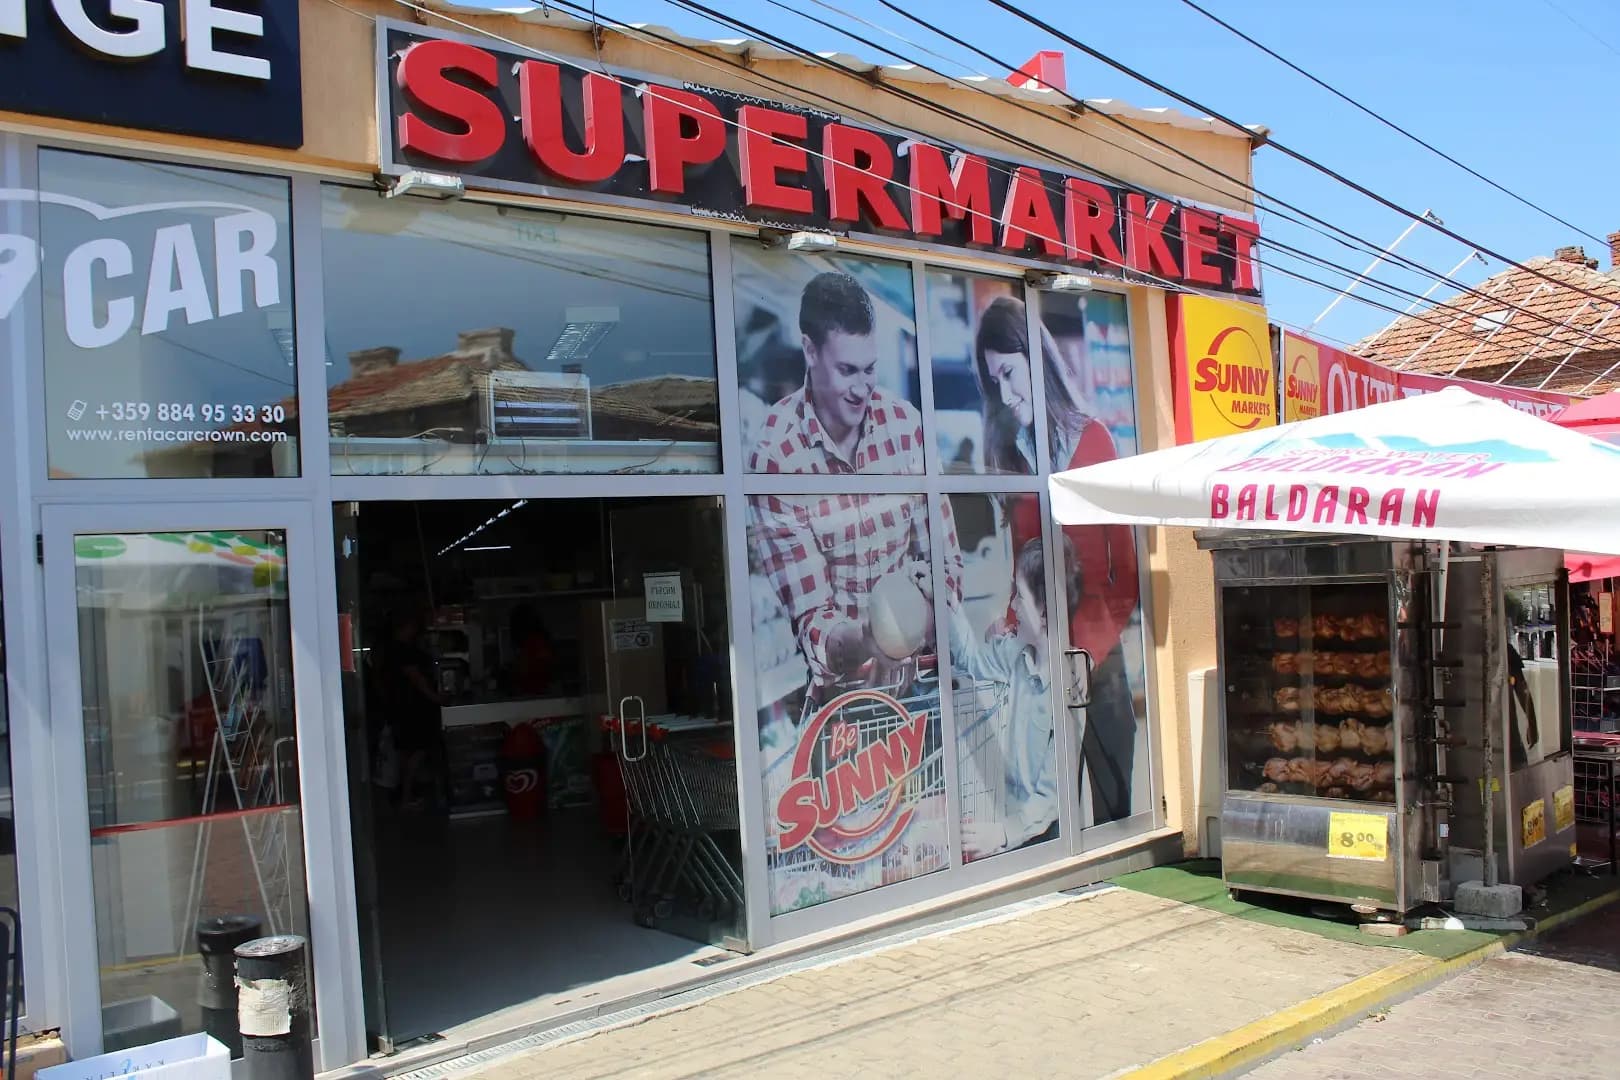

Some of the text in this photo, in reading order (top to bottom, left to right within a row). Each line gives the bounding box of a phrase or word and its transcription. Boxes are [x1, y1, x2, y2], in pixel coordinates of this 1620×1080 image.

[0, 0, 271, 80] GE
[396, 38, 1262, 292] SUPERMARKET
[63, 212, 281, 348] CAR
[1195, 356, 1269, 396] SUNNY
[1287, 374, 1318, 404] SUNNY
[95, 402, 285, 423] +359 884 95 33 30
[1231, 399, 1271, 417] MARKETS
[66, 427, 288, 442] www.rentacarcrown.com
[1219, 456, 1506, 479] BALDARAN
[1211, 483, 1441, 529] BALDARAN
[831, 721, 858, 757] Be
[777, 712, 928, 852] SUNNY
